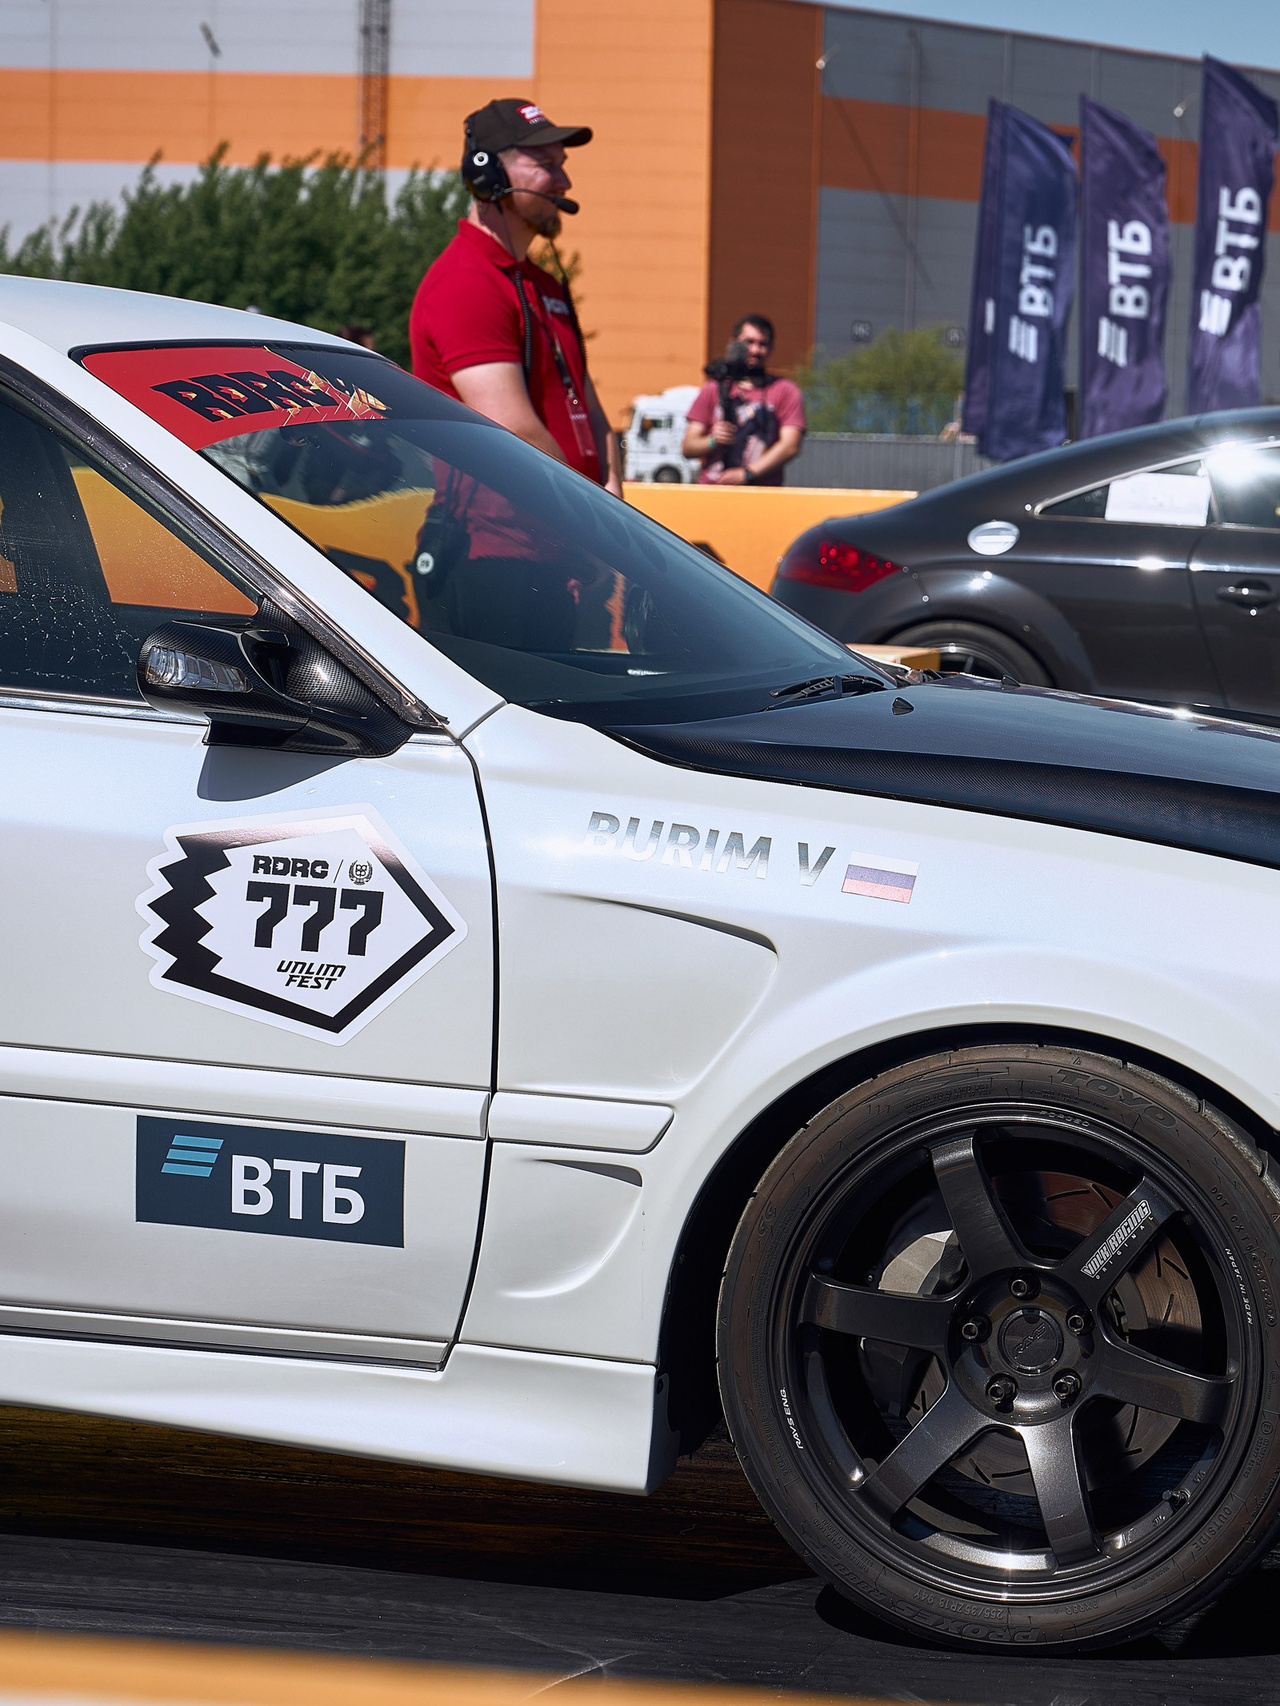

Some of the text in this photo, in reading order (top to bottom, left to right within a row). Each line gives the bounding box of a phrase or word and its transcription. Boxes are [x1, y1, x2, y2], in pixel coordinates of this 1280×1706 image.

[1018, 223, 1058, 318] ВТБ
[1107, 219, 1152, 319] ВТБ
[1212, 185, 1262, 292] ВТБ
[253, 855, 329, 880] RDRC
[584, 811, 837, 887] BURIM V
[246, 880, 384, 957] 777
[276, 960, 347, 978] UNLIM
[285, 975, 338, 990] FEST
[1055, 1067, 1179, 1131] TOYO
[231, 1154, 366, 1225] ВТБ
[1208, 1184, 1230, 1209] DOT
[1095, 1216, 1153, 1280] ORIGINAL
[1106, 1200, 1152, 1255] RACING
[1223, 1246, 1254, 1325] MADE IN JAPAN
[777, 1385, 805, 1451] RAYS ENG.
[1191, 1505, 1233, 1552] OUTSIDE
[892, 1597, 1041, 1641] PROXES
[912, 1586, 1004, 1620] 255/35ZR18 94Y
